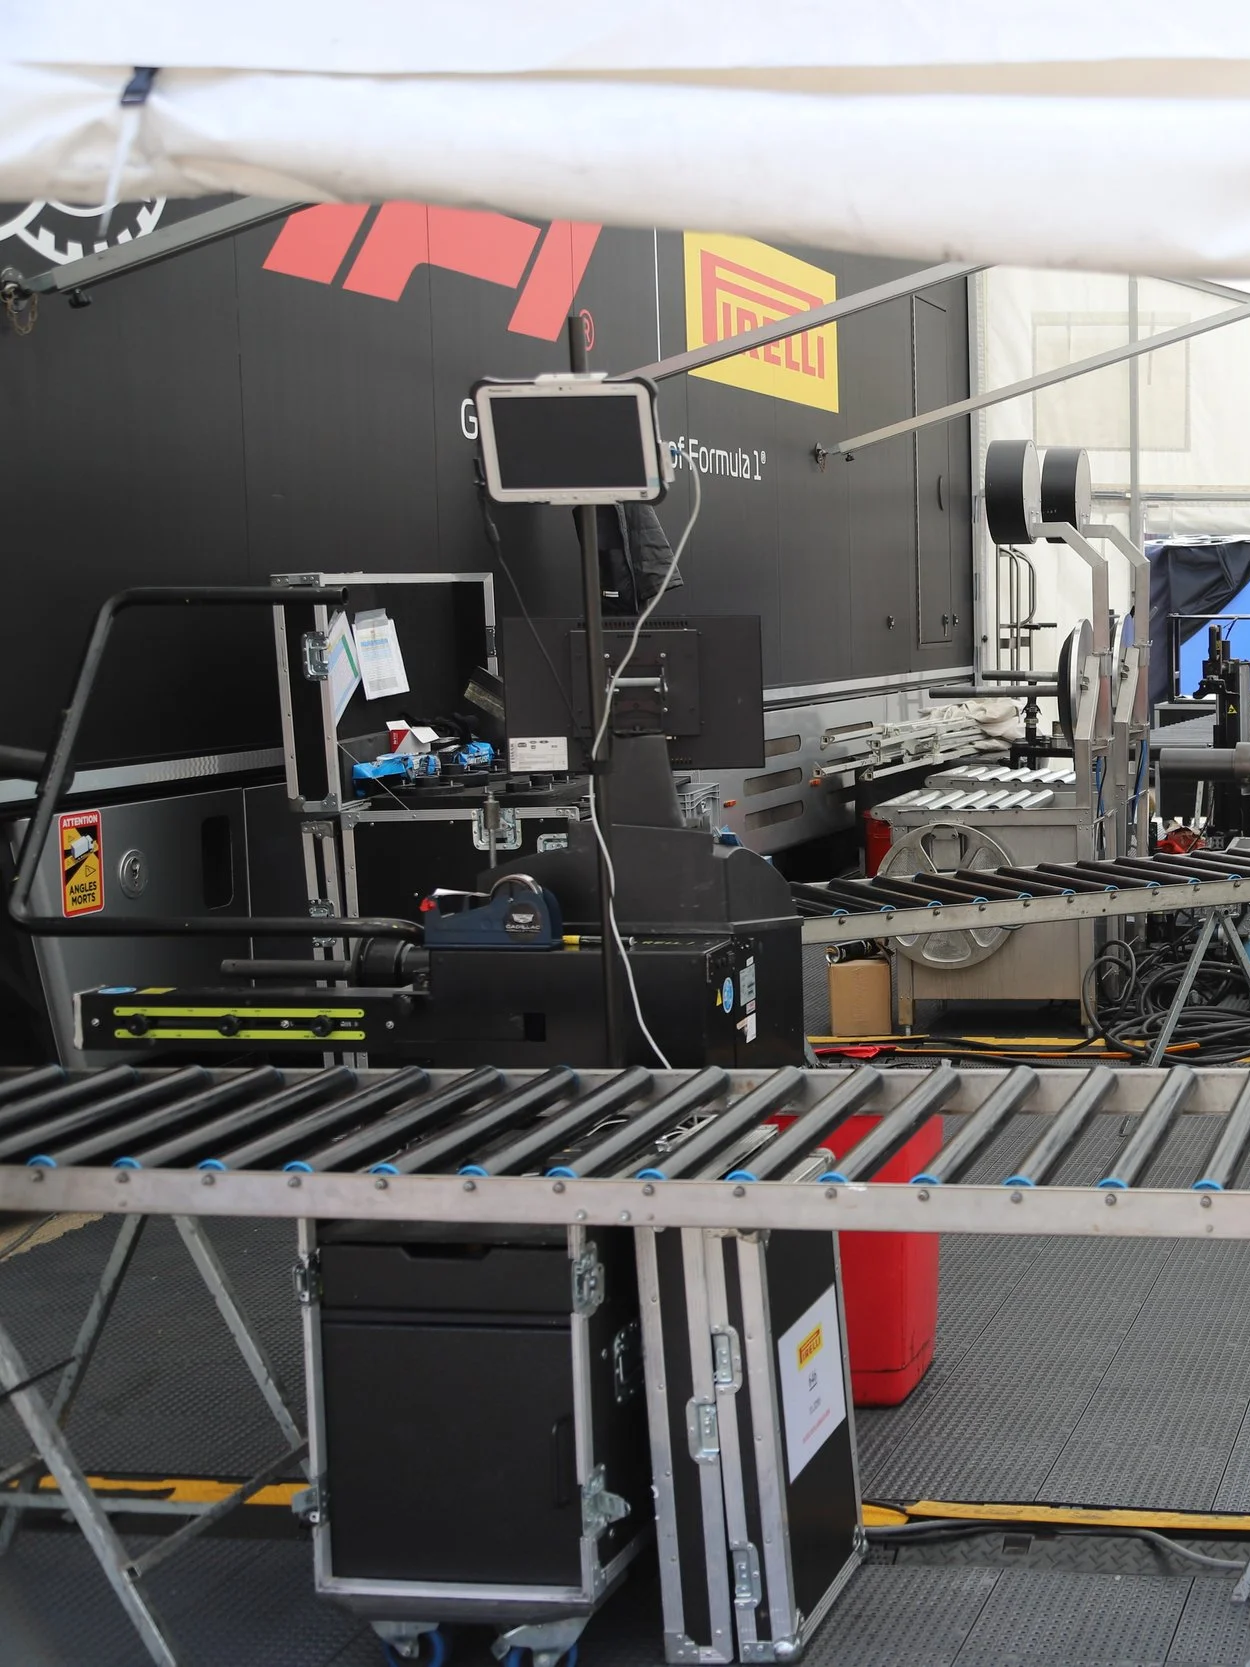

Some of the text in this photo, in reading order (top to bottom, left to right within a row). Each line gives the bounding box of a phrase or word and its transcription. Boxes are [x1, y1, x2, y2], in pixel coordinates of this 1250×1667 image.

[689, 438, 750, 479] Formula
[62, 814, 98, 828] ATTENTION
[69, 881, 97, 895] ANGLES
[71, 892, 96, 906] MORTS
[799, 1328, 822, 1365] PIRELLI
